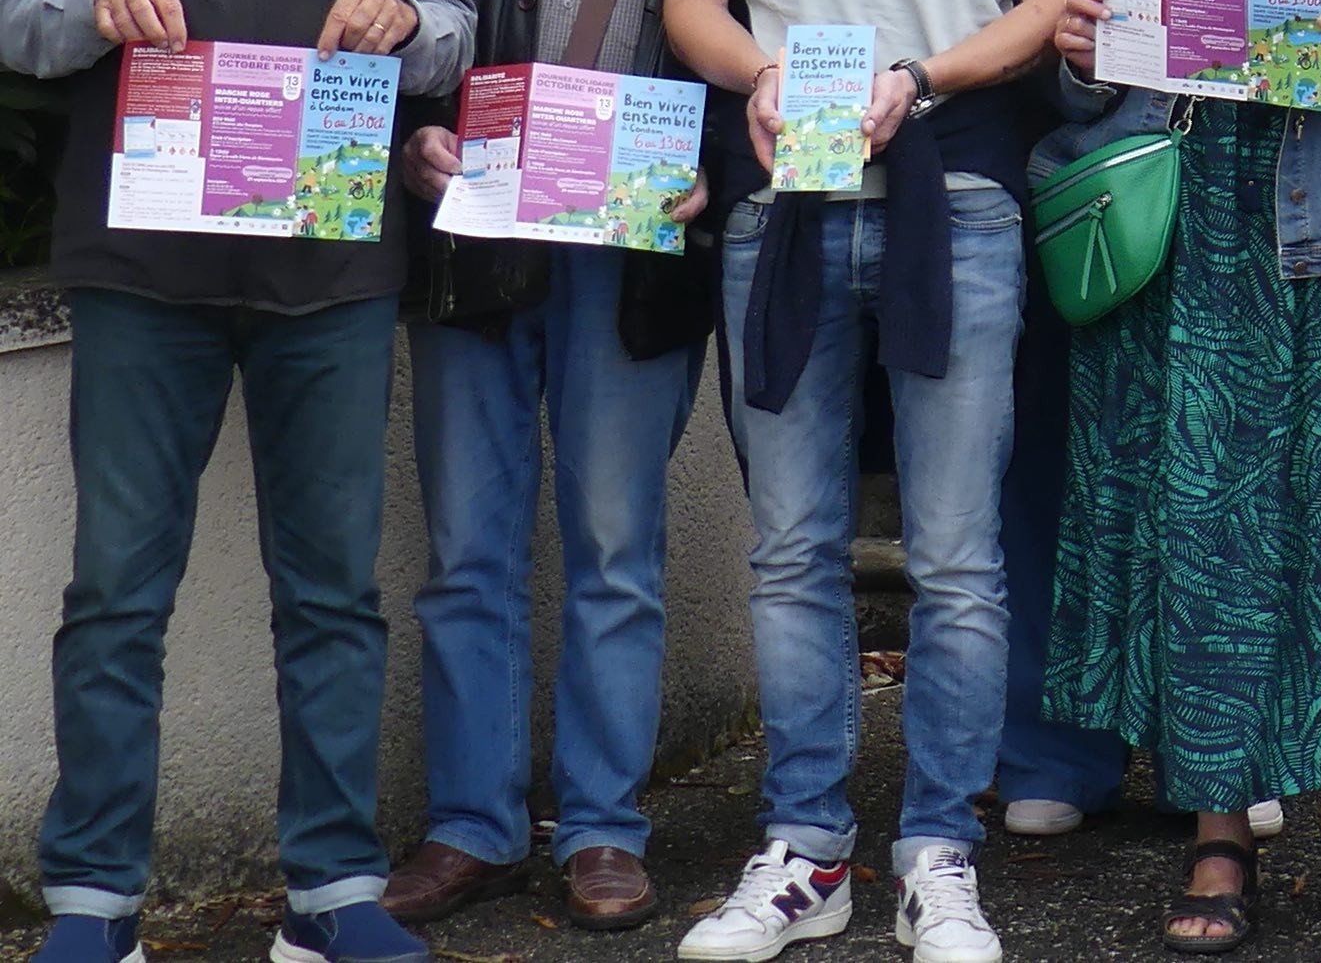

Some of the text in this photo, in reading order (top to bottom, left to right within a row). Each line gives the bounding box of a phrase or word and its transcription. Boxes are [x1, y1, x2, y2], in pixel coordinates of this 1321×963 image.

[792, 42, 866, 57] Bien vivre
[218, 60, 304, 73] OCTOBRE ROSE
[791, 59, 867, 70] ensemble
[313, 68, 390, 89] Bien vivre
[311, 87, 390, 105] ensemble
[624, 93, 696, 115] Bien vivre
[622, 111, 697, 129] ensemble
